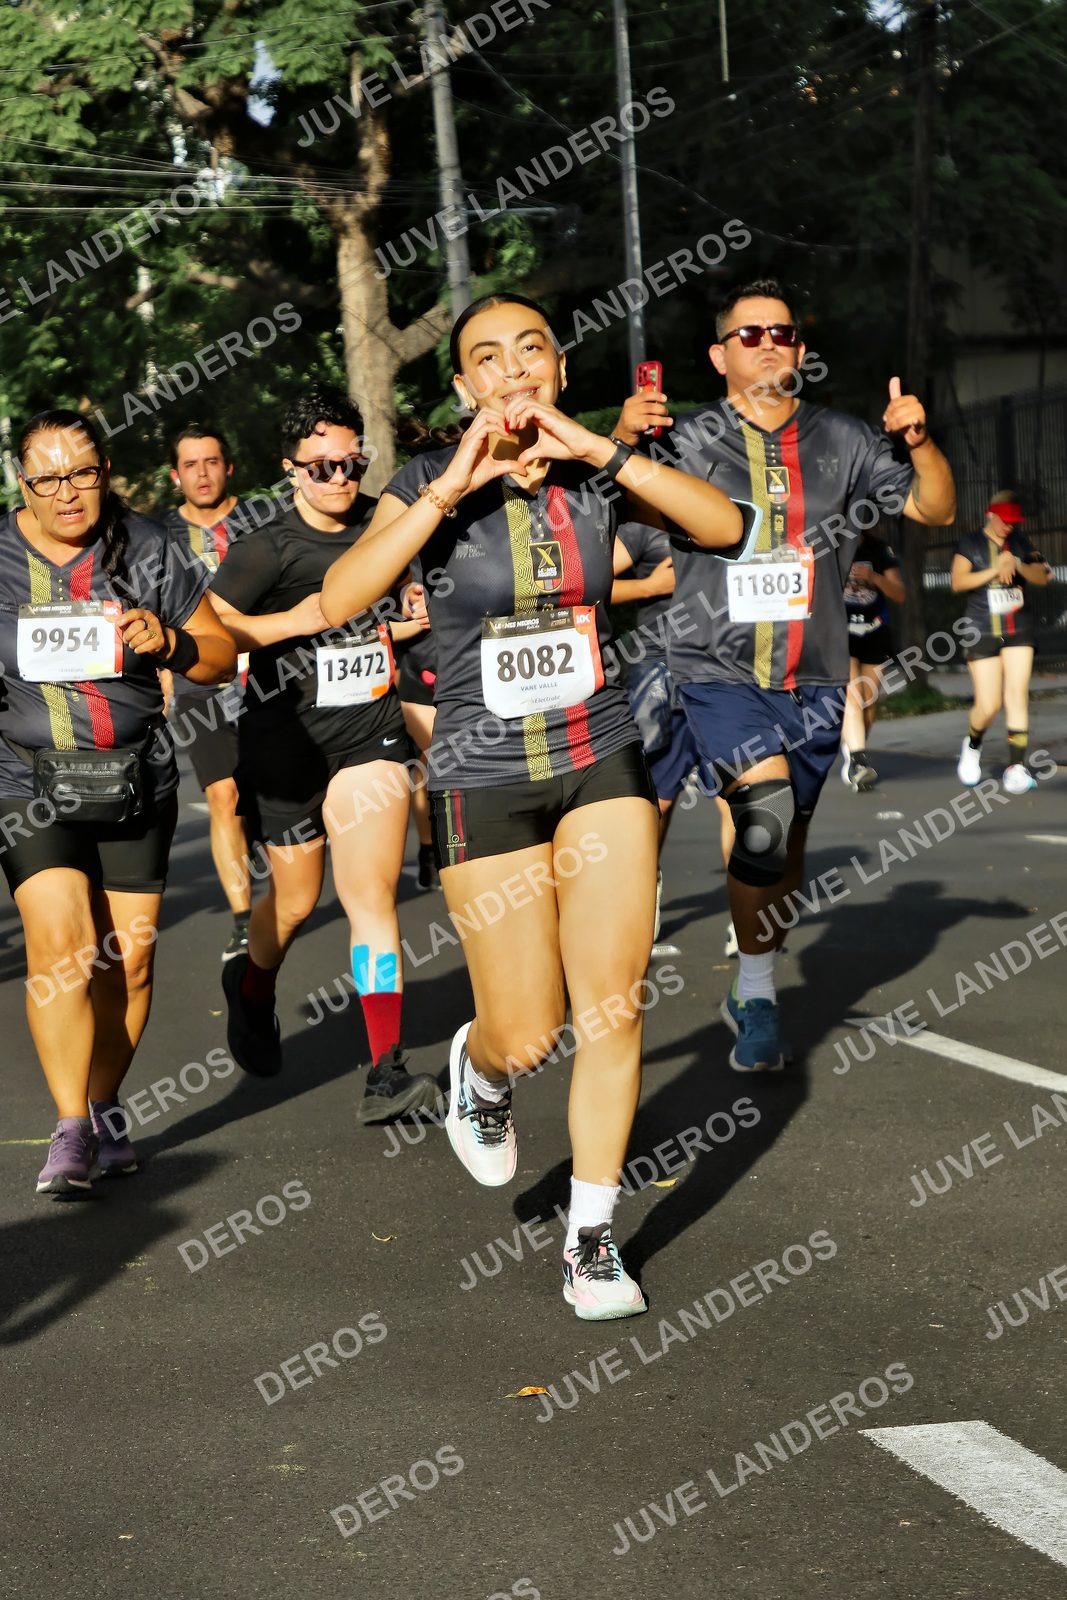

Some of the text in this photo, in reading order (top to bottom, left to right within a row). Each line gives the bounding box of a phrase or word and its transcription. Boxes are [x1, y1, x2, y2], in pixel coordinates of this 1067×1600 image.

[733, 572, 803, 597] 11803
[575, 613, 591, 624] 10K
[32, 627, 99, 653] 9954
[323, 651, 385, 682] 13472
[497, 642, 575, 682] 8082
[520, 684, 537, 692] VANE
